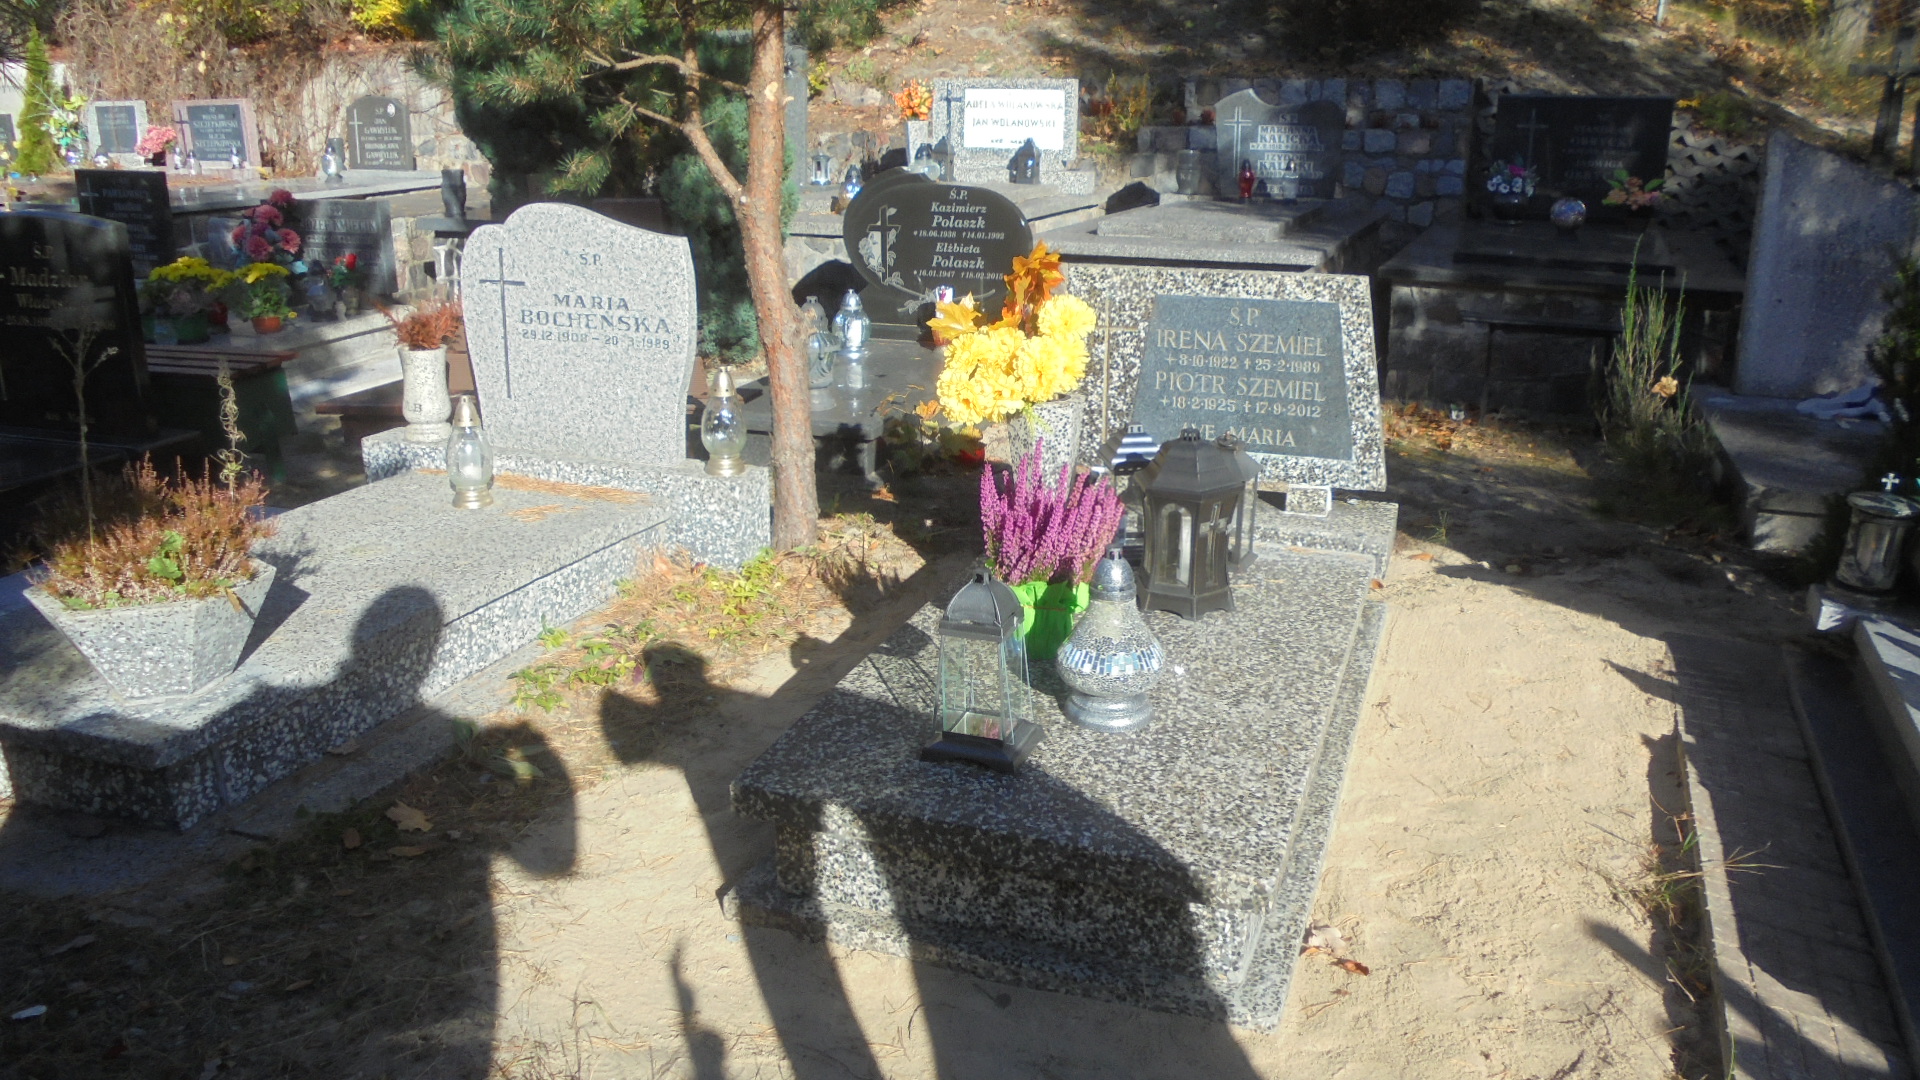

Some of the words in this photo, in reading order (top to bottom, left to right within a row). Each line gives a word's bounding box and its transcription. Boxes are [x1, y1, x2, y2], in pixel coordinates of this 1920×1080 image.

[972, 117, 988, 127] JAN
[990, 117, 1056, 127] WOLANOWSKI
[1258, 133, 1319, 144] KALICKA
[949, 187, 968, 200] Ś.P.
[931, 201, 988, 214] Kazimierz
[931, 214, 986, 229] Polaszk
[935, 242, 981, 254] Elżbieta
[931, 254, 985, 270] Polaszk
[552, 293, 630, 311] MARIA
[520, 309, 671, 334] BOCHENSKA
[1156, 328, 1228, 352] IRENA
[1236, 333, 1327, 357] SZEMIEL
[1154, 370, 1226, 395] PIOTR
[1236, 377, 1327, 402] SZEMIEL
[1228, 426, 1296, 448] MARIA
